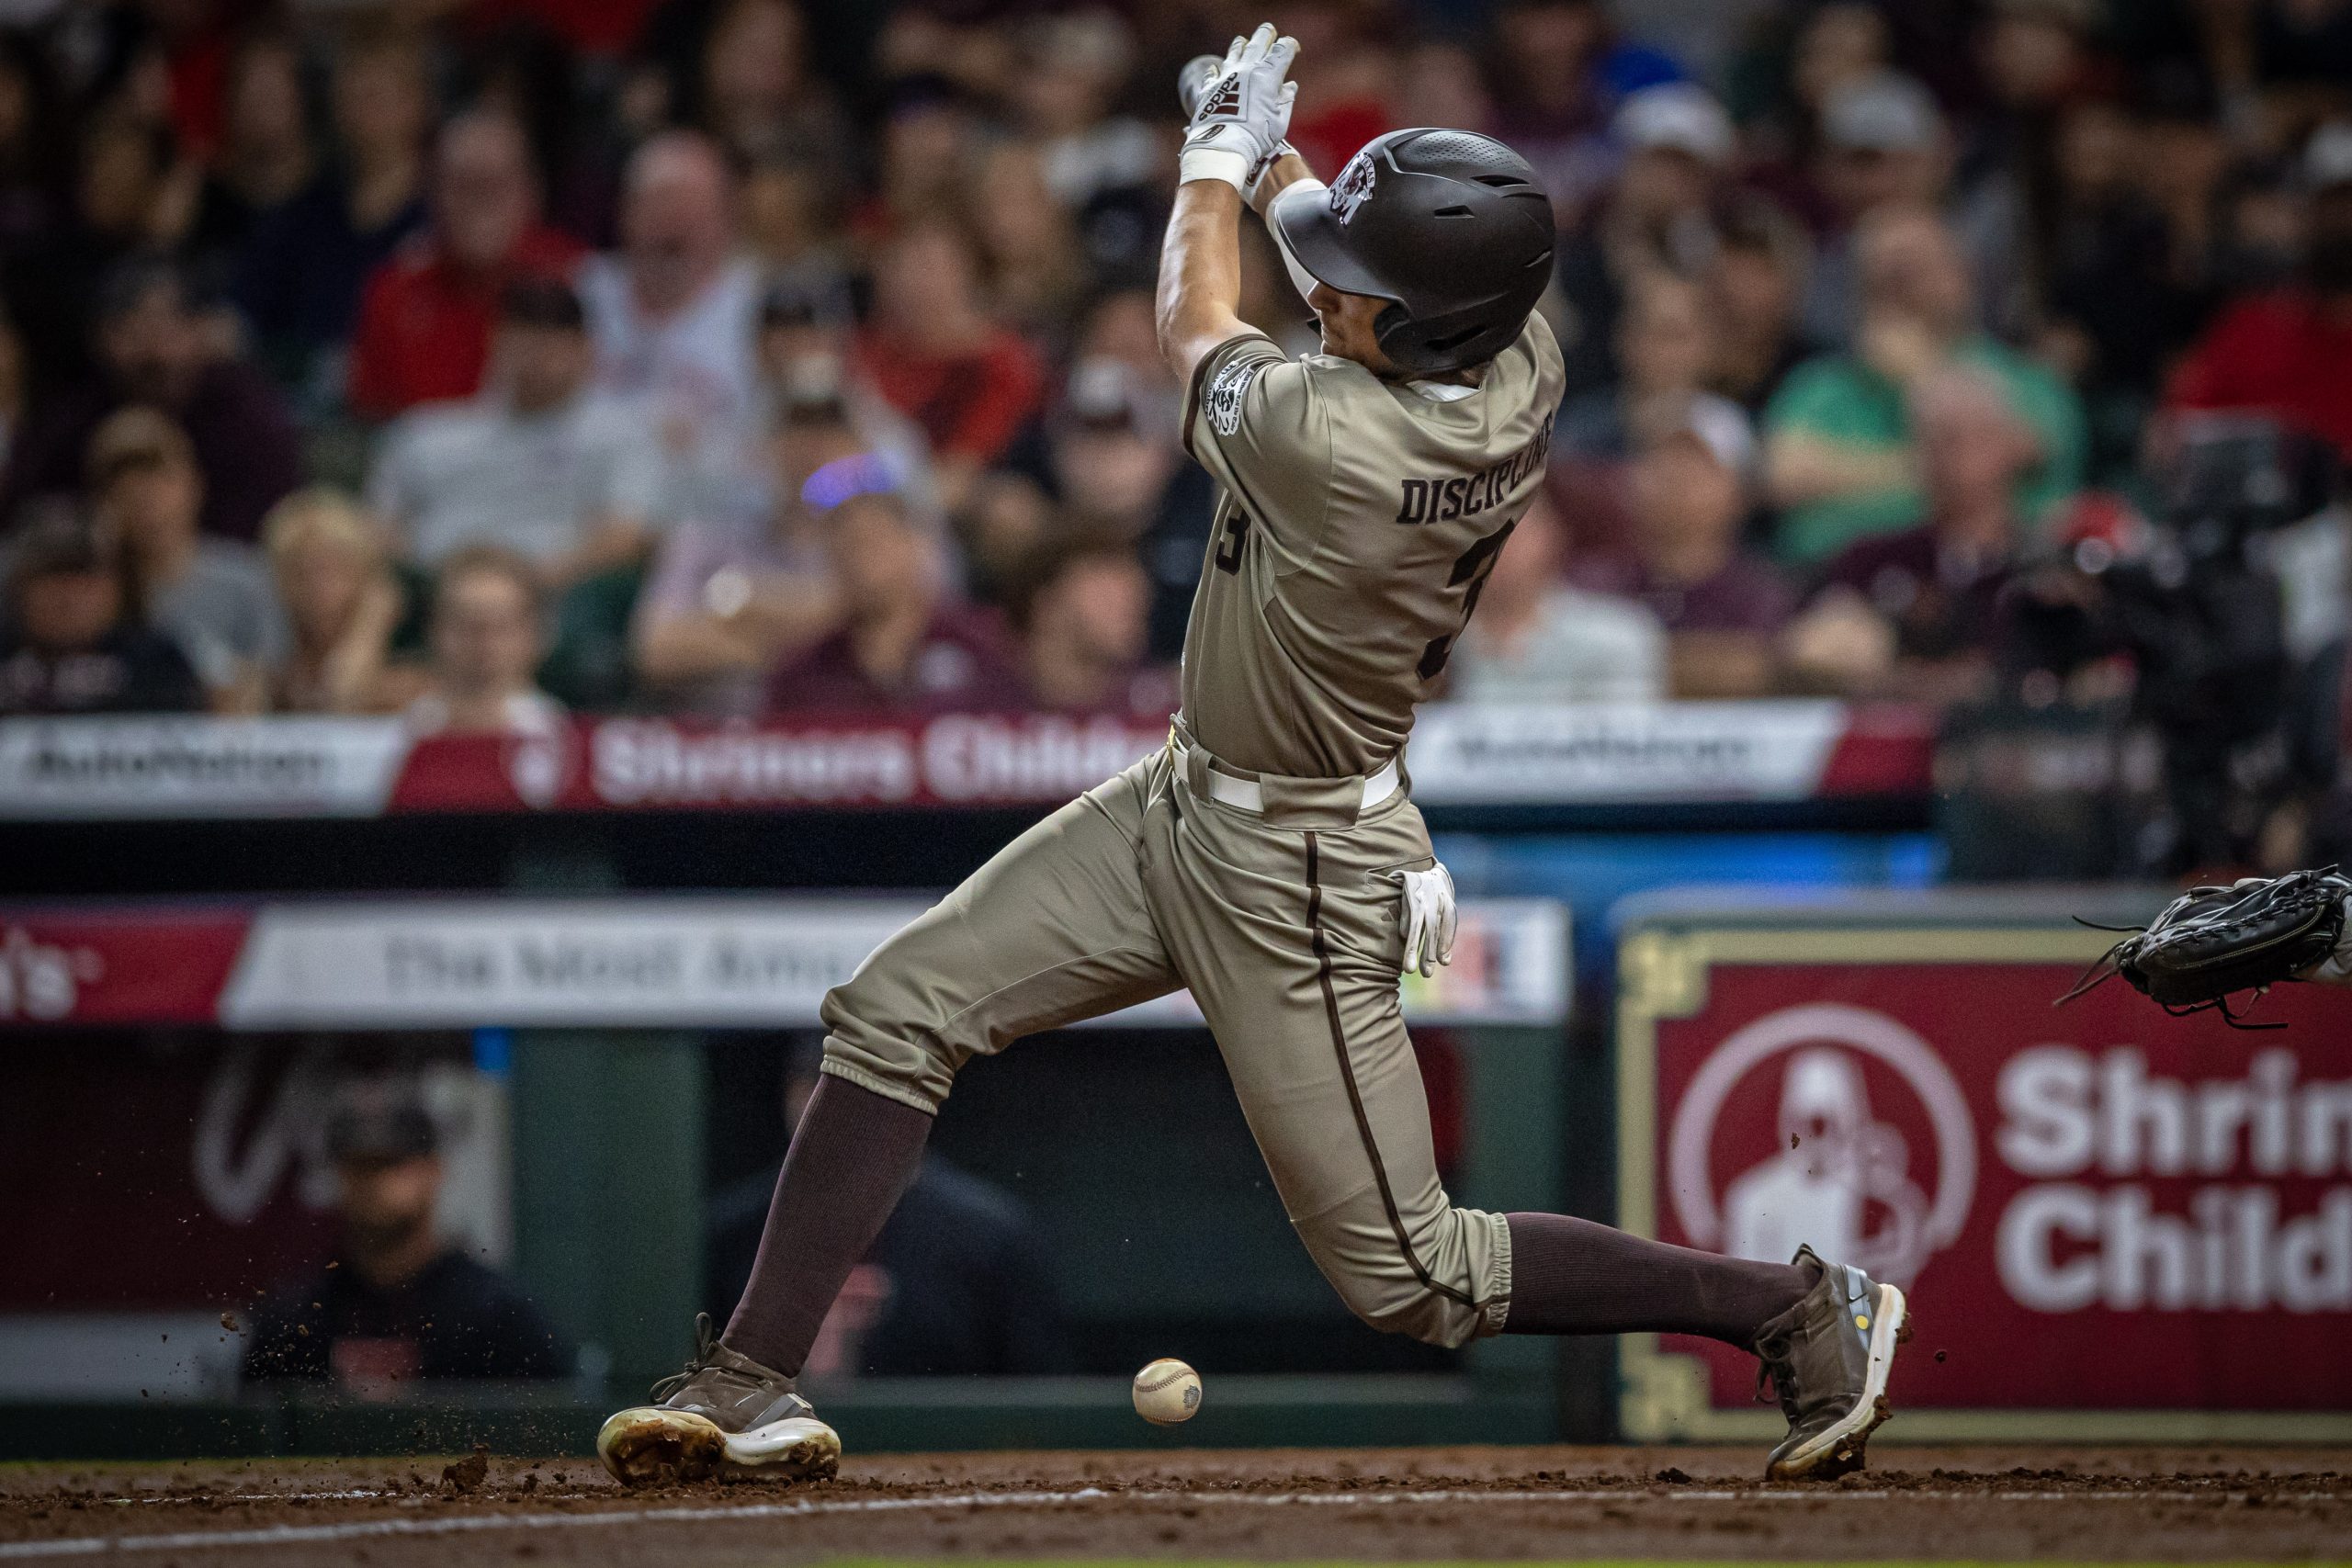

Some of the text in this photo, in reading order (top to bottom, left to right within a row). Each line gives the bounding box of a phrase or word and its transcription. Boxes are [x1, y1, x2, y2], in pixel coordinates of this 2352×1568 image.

[1198, 72, 1238, 121] adidas
[1360, 155, 1375, 184] TEXAS
[1396, 409, 1553, 525] DISCIPLINE
[1994, 1181, 2352, 1314] Child
